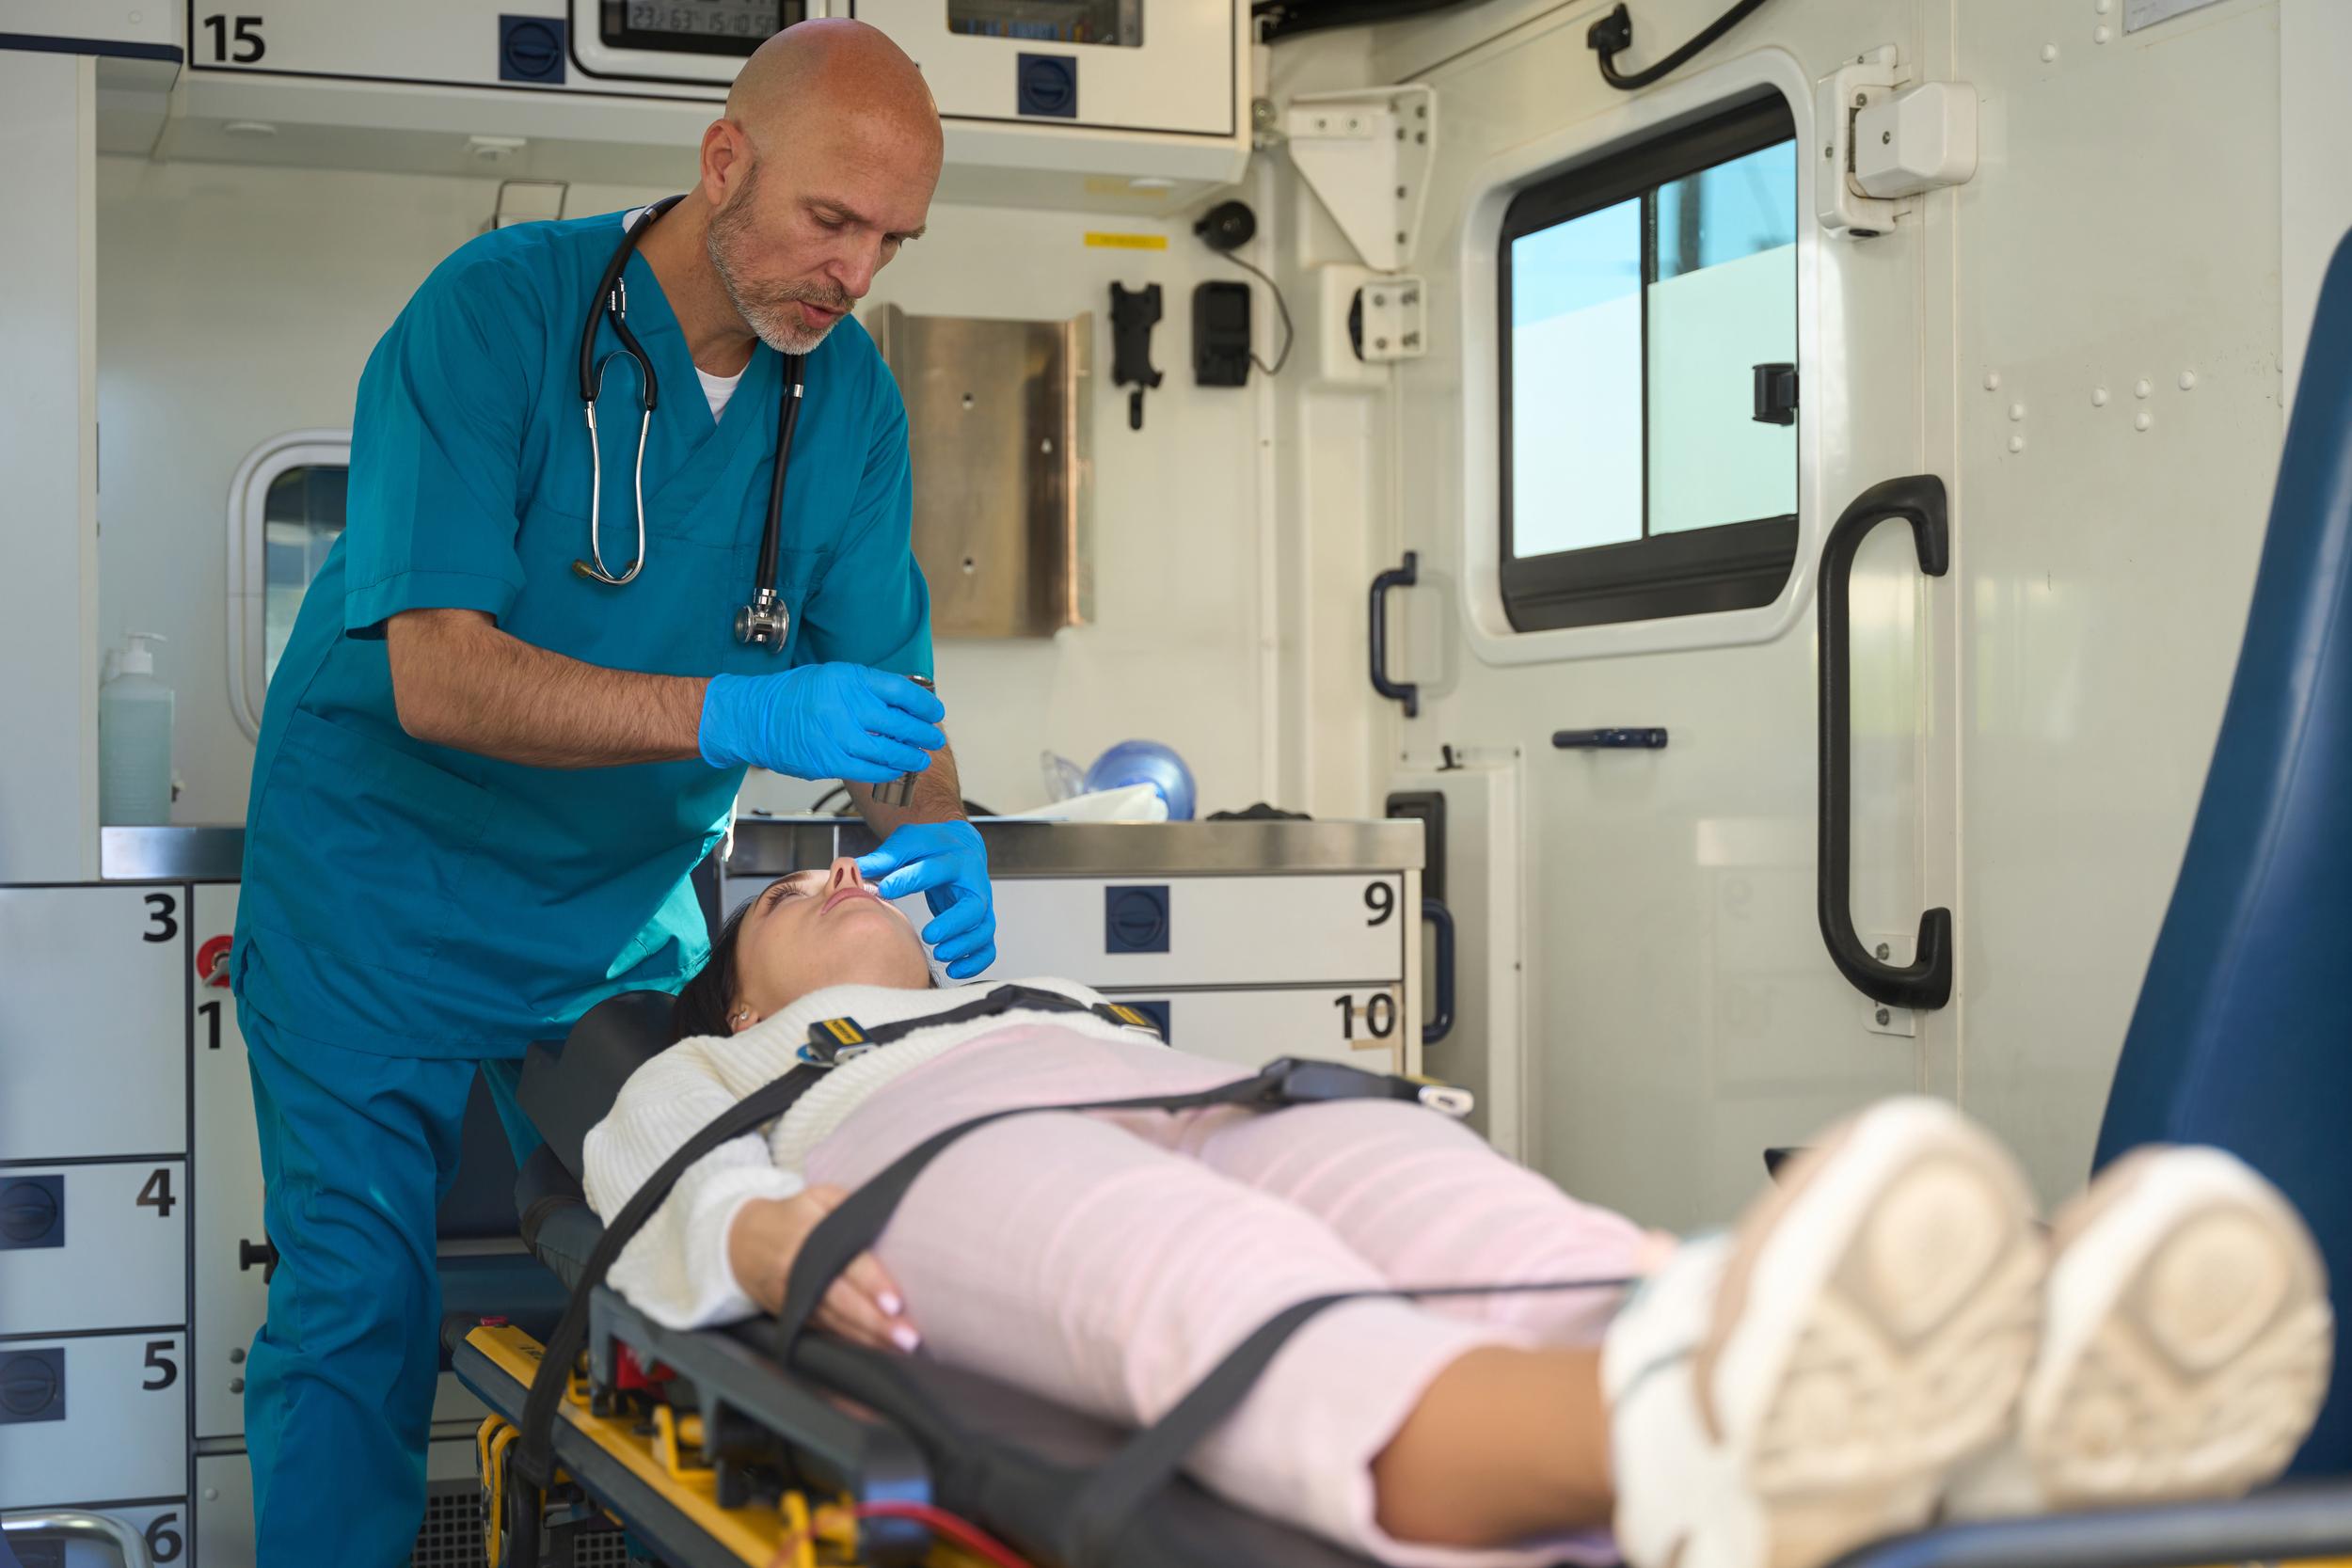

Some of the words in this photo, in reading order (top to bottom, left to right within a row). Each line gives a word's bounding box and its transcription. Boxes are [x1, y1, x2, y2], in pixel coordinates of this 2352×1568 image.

[203, 14, 265, 63] 15
[142, 893, 179, 942] 3
[1363, 881, 1394, 927] 9
[198, 1000, 222, 1050] 1
[1333, 993, 1397, 1039] 10
[135, 1168, 177, 1217] 4
[142, 1339, 179, 1391] 5
[145, 1513, 183, 1563] 6
